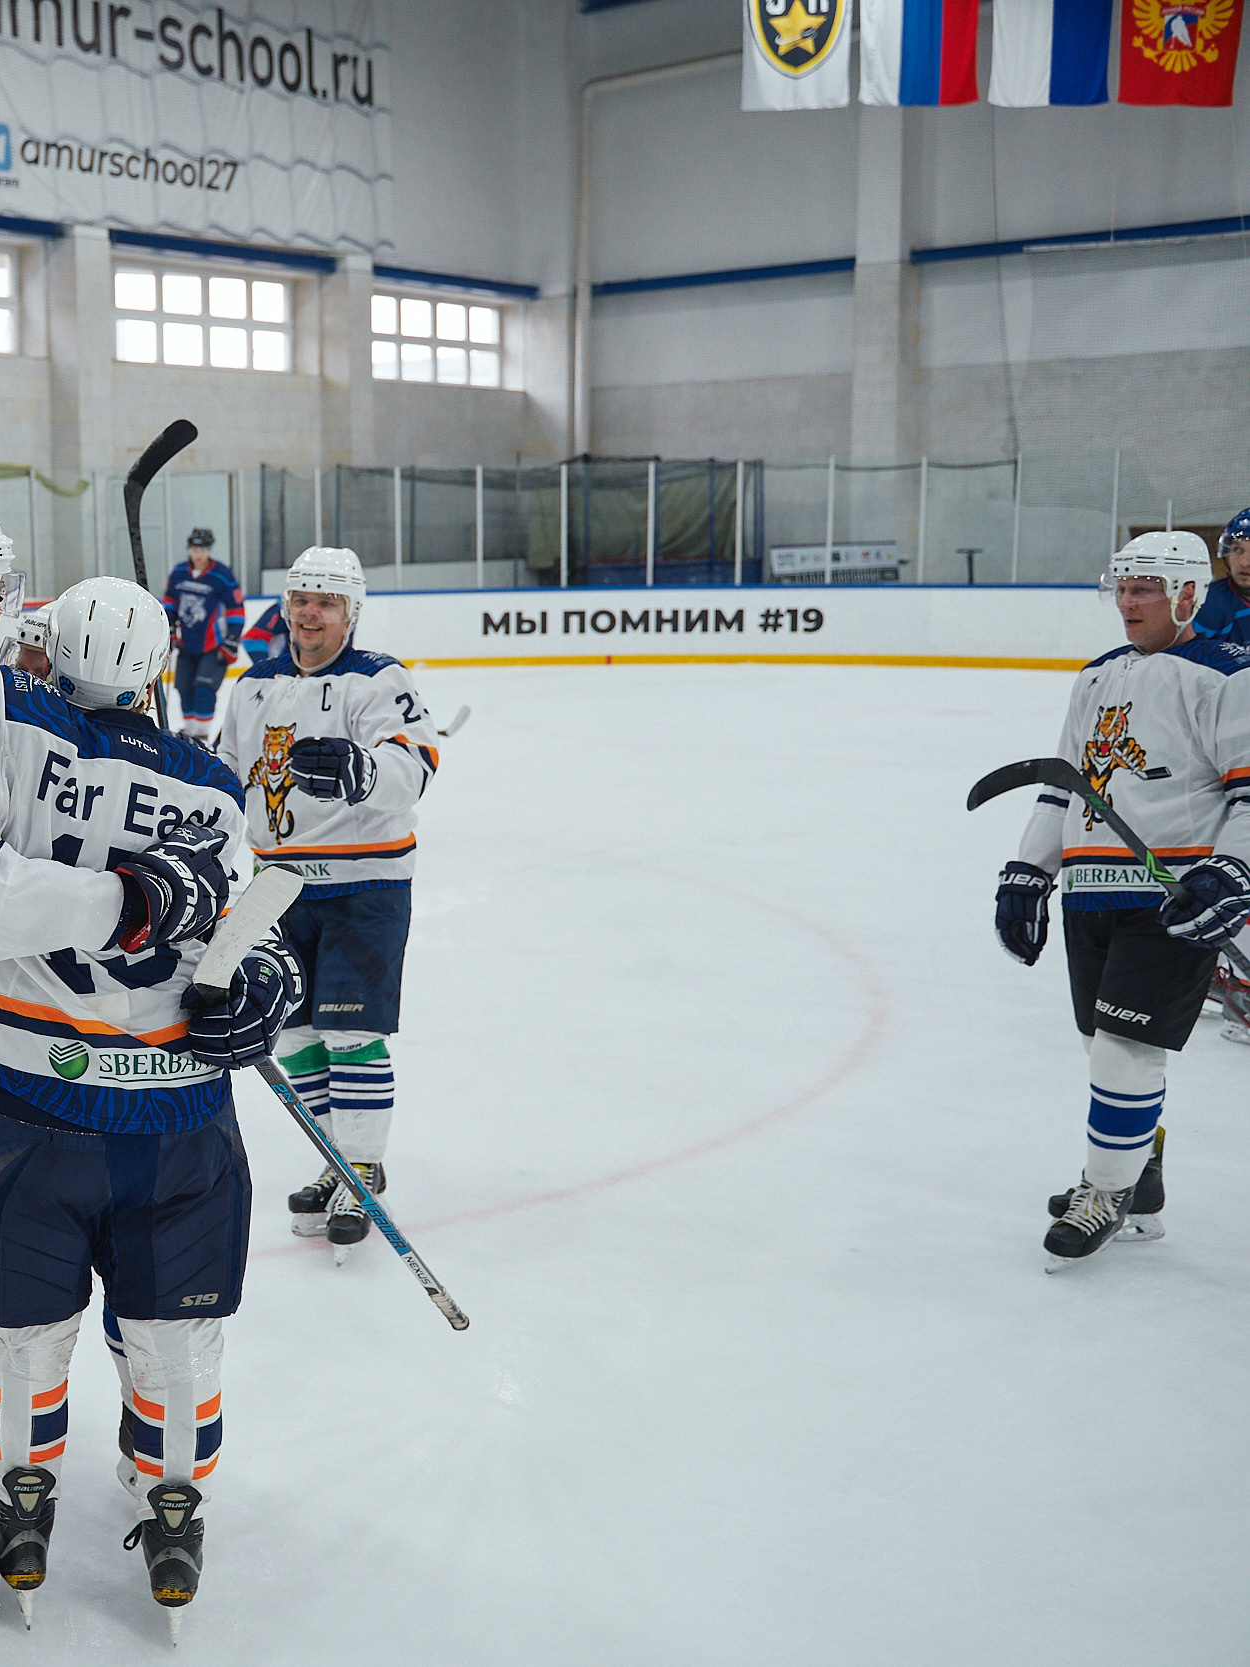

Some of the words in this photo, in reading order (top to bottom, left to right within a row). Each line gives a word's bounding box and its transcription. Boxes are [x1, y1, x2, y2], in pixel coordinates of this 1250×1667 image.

[20, 138, 238, 192] amurschool27
[482, 610, 547, 636] МЫ
[562, 608, 745, 634] ПОМНИМ
[759, 608, 824, 633] #19
[321, 683, 333, 712] C
[395, 690, 430, 724] 2
[120, 734, 159, 755] LUTCH
[36, 749, 105, 821] Far
[999, 872, 1046, 890] UER
[1075, 868, 1154, 883] BERBAN
[318, 1003, 365, 1012] BAUER
[1094, 998, 1152, 1026] BAUER
[99, 1053, 212, 1076] SBERBA
[366, 1209, 407, 1249] BAUER
[404, 1255, 431, 1286] NEXUS
[179, 1293, 219, 1308] S19
